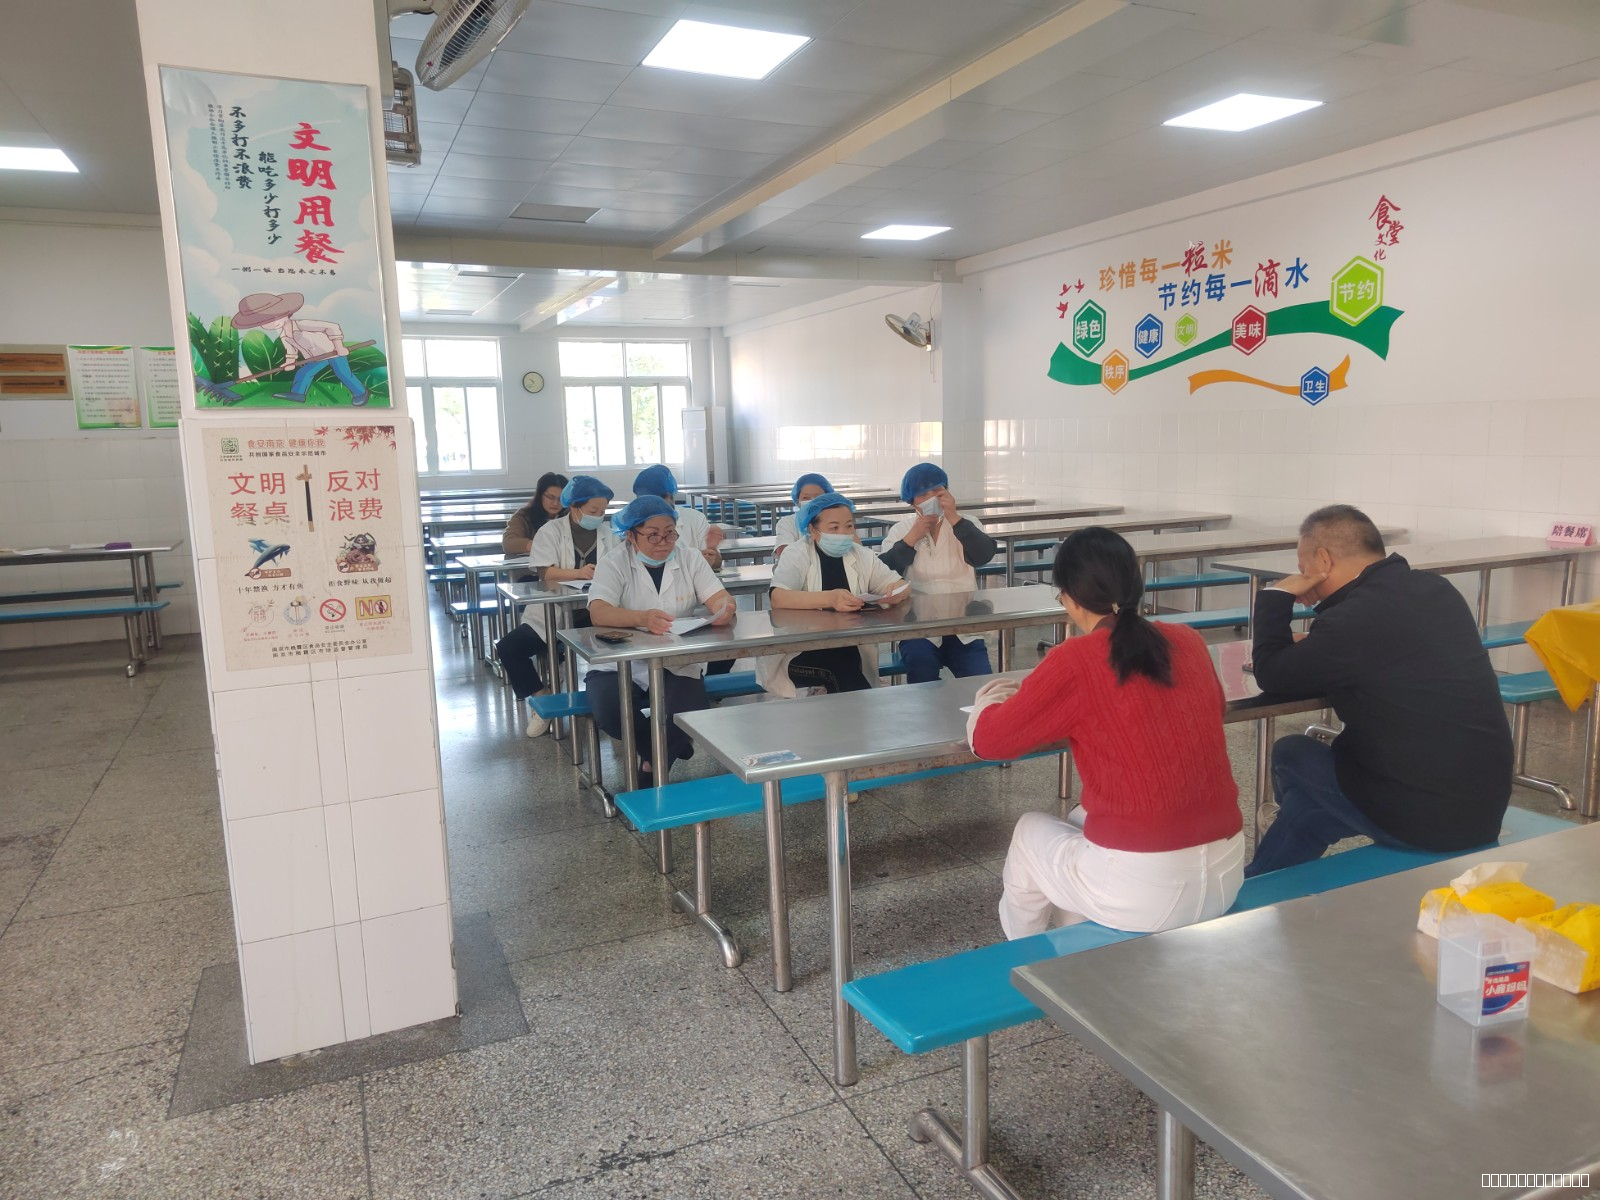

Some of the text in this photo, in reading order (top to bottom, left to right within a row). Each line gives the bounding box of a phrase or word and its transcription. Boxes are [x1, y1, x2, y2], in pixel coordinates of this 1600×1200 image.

[229, 106, 255, 190] 不多打不浪费
[258, 151, 282, 245] 能吃多少打多少
[286, 122, 344, 264] 文明用餐
[1099, 240, 1233, 292] 珍惜每一粒米
[1158, 257, 1309, 311] 节约每一滴水
[1338, 279, 1375, 304] 节约
[1076, 319, 1101, 340] 绿色
[1138, 328, 1159, 345] 健康
[1177, 323, 1194, 336] 文明
[1235, 321, 1262, 339] 美味
[1105, 365, 1125, 380] 秩序
[1303, 380, 1325, 394] 卫生
[228, 472, 286, 495] 文明
[326, 468, 381, 493] 反对
[230, 501, 290, 526] 餐桌
[330, 498, 383, 521] 浪费
